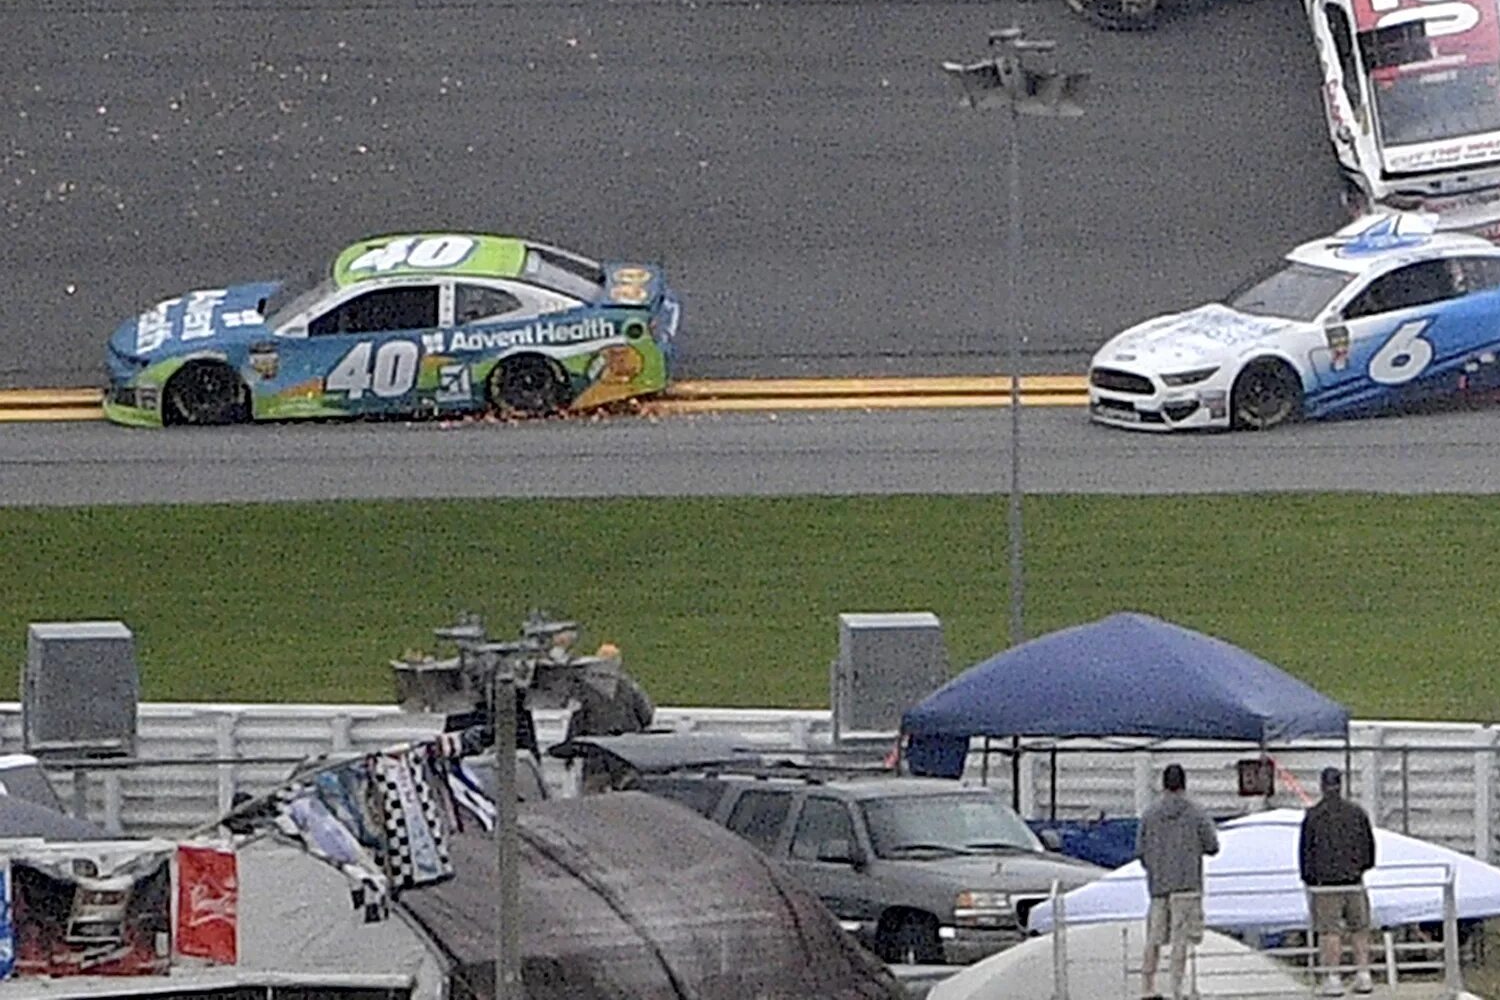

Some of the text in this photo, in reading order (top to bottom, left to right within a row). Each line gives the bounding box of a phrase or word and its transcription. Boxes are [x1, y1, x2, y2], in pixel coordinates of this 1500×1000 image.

[348, 233, 478, 271] 40
[326, 340, 419, 399] 40
[1367, 317, 1436, 386] 6
